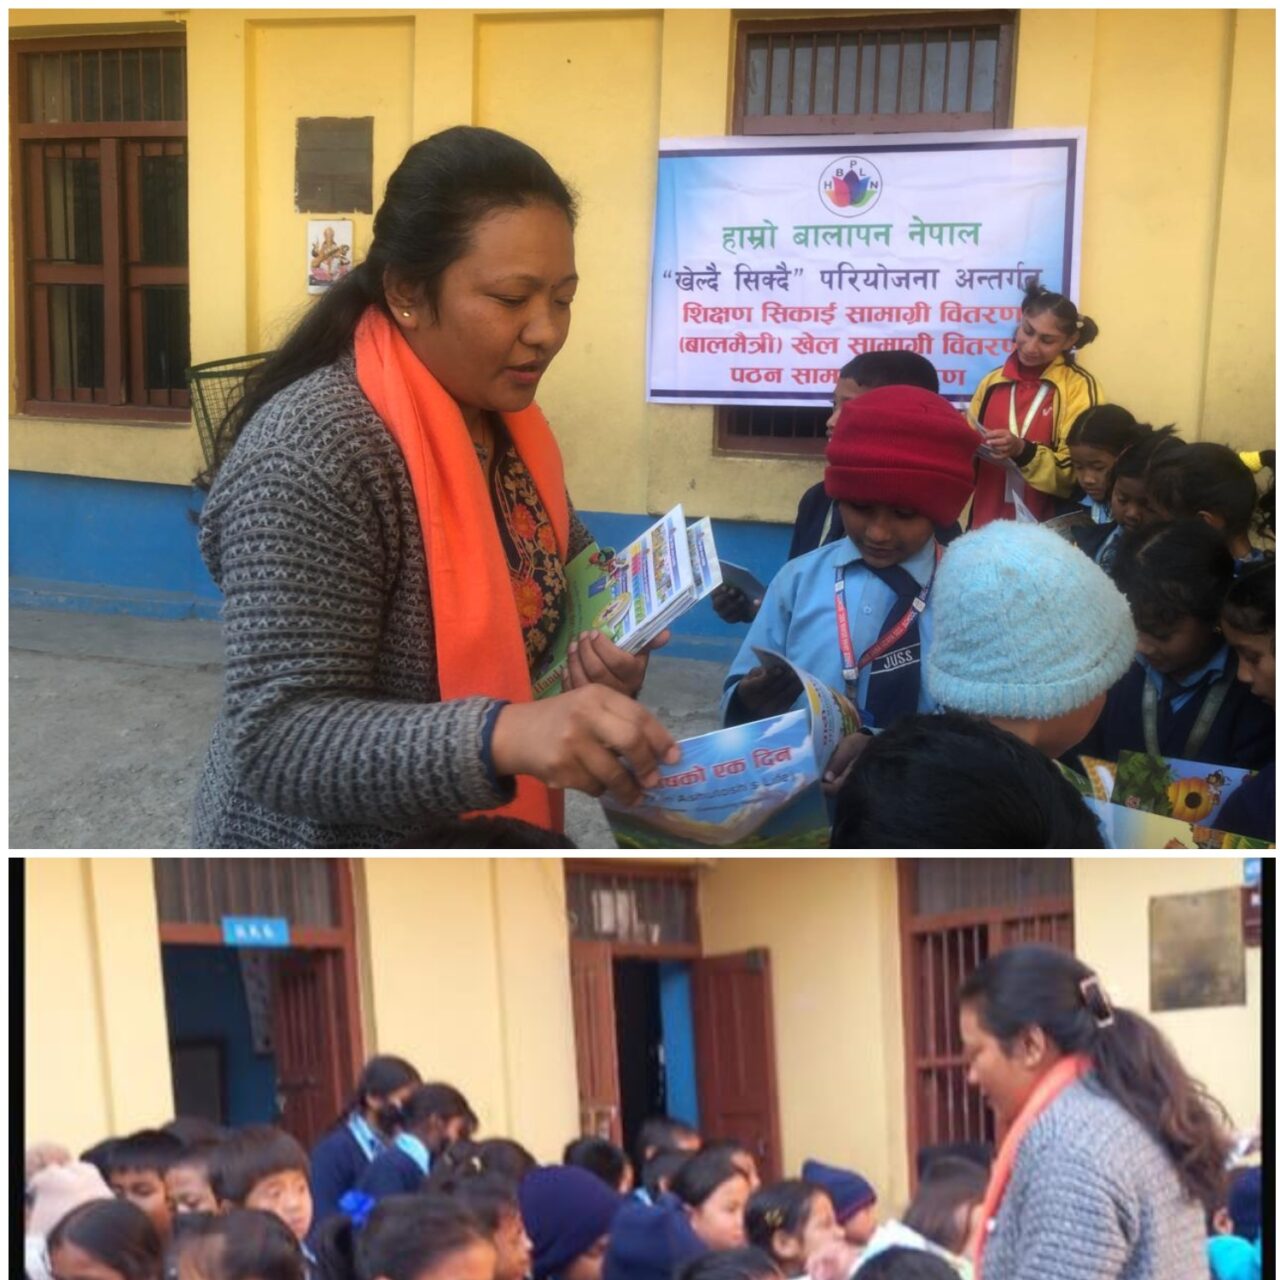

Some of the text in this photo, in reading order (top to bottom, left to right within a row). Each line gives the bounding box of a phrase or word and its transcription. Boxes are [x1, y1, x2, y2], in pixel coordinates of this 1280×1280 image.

[722, 216, 982, 255] हाम्रो बालापन नेपाल
[820, 261, 939, 292] परियोजना
[683, 302, 752, 325] शिक्षण
[762, 301, 835, 326] सिकाई
[846, 300, 931, 325] सामाग्री
[791, 333, 839, 355] खेल
[731, 366, 783, 386] पठन
[883, 649, 913, 669] JUSS
[712, 757, 746, 778] एक
[752, 746, 792, 768] दिन
